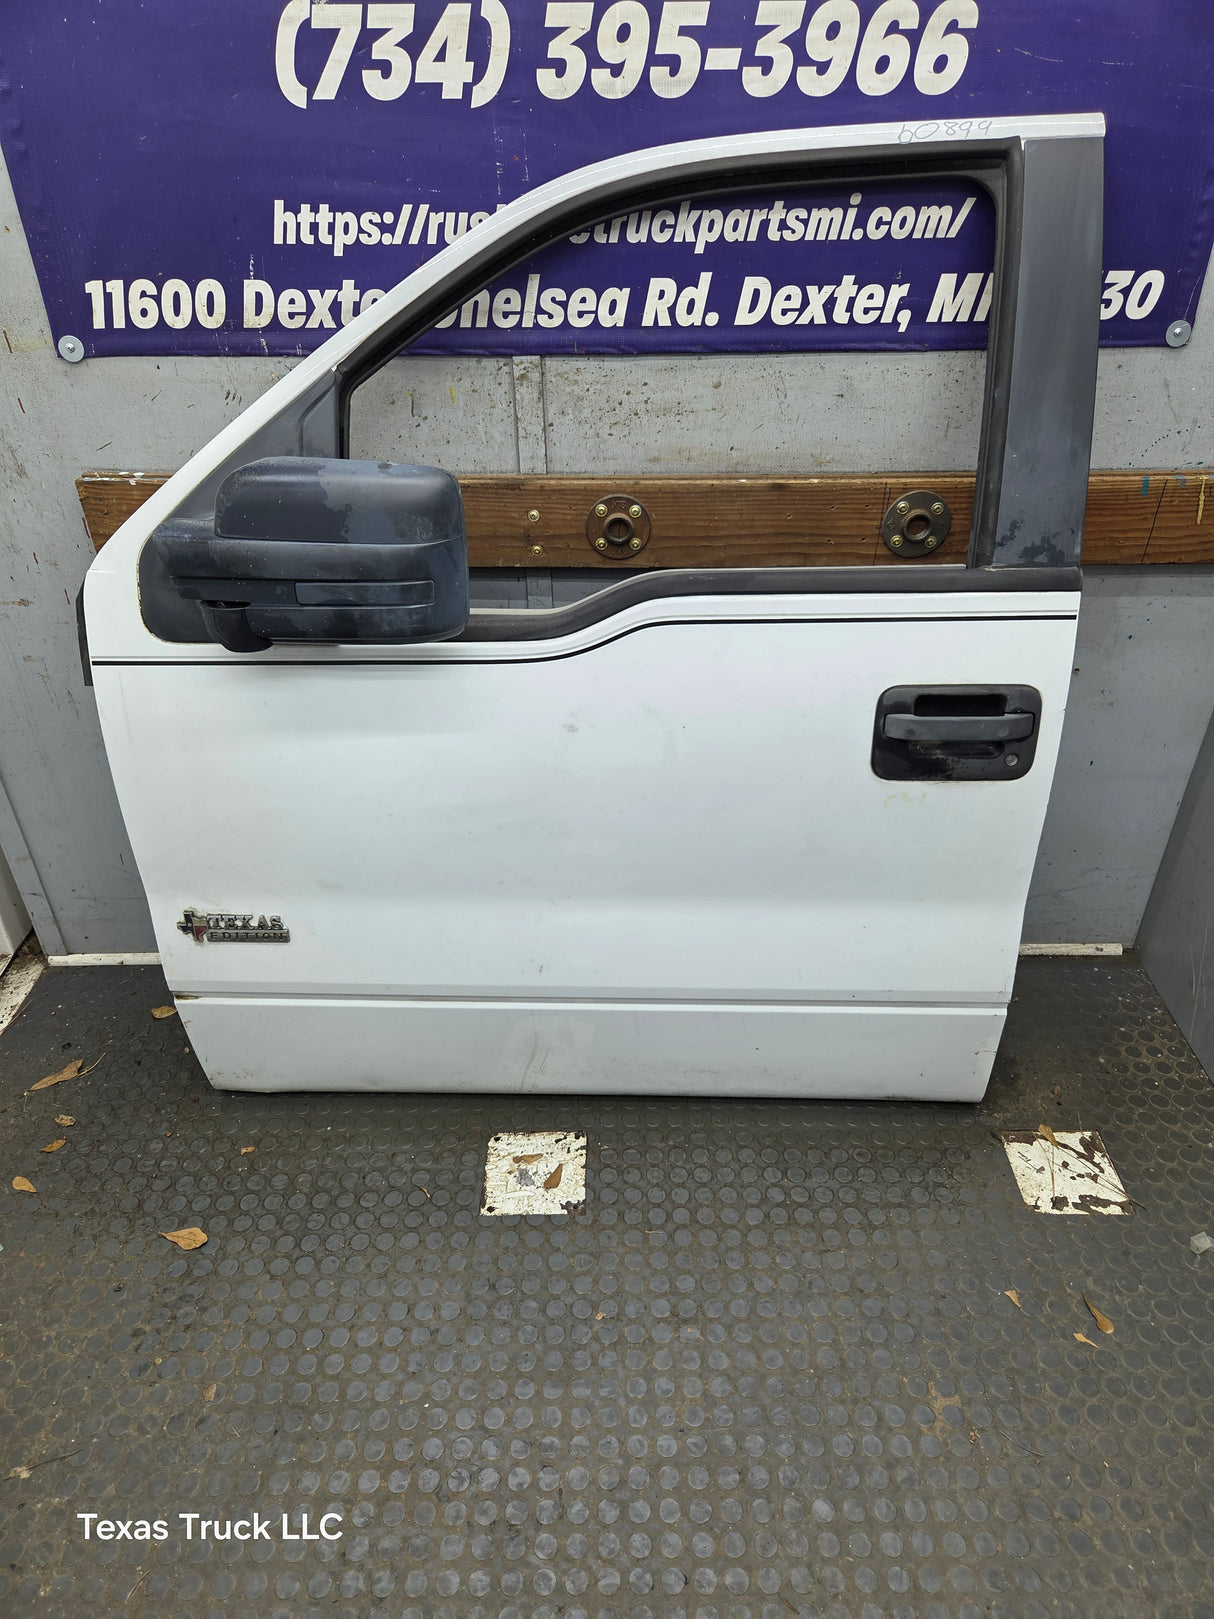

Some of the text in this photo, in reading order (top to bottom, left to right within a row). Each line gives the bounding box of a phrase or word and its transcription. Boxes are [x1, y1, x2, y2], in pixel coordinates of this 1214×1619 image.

[275, 0, 979, 109] (734) 395-3966
[84, 278, 226, 330] 11600
[641, 272, 720, 327] Rd.
[734, 275, 911, 333] Dexter,
[206, 913, 283, 930] TEXAS
[210, 931, 284, 940] EDITION
